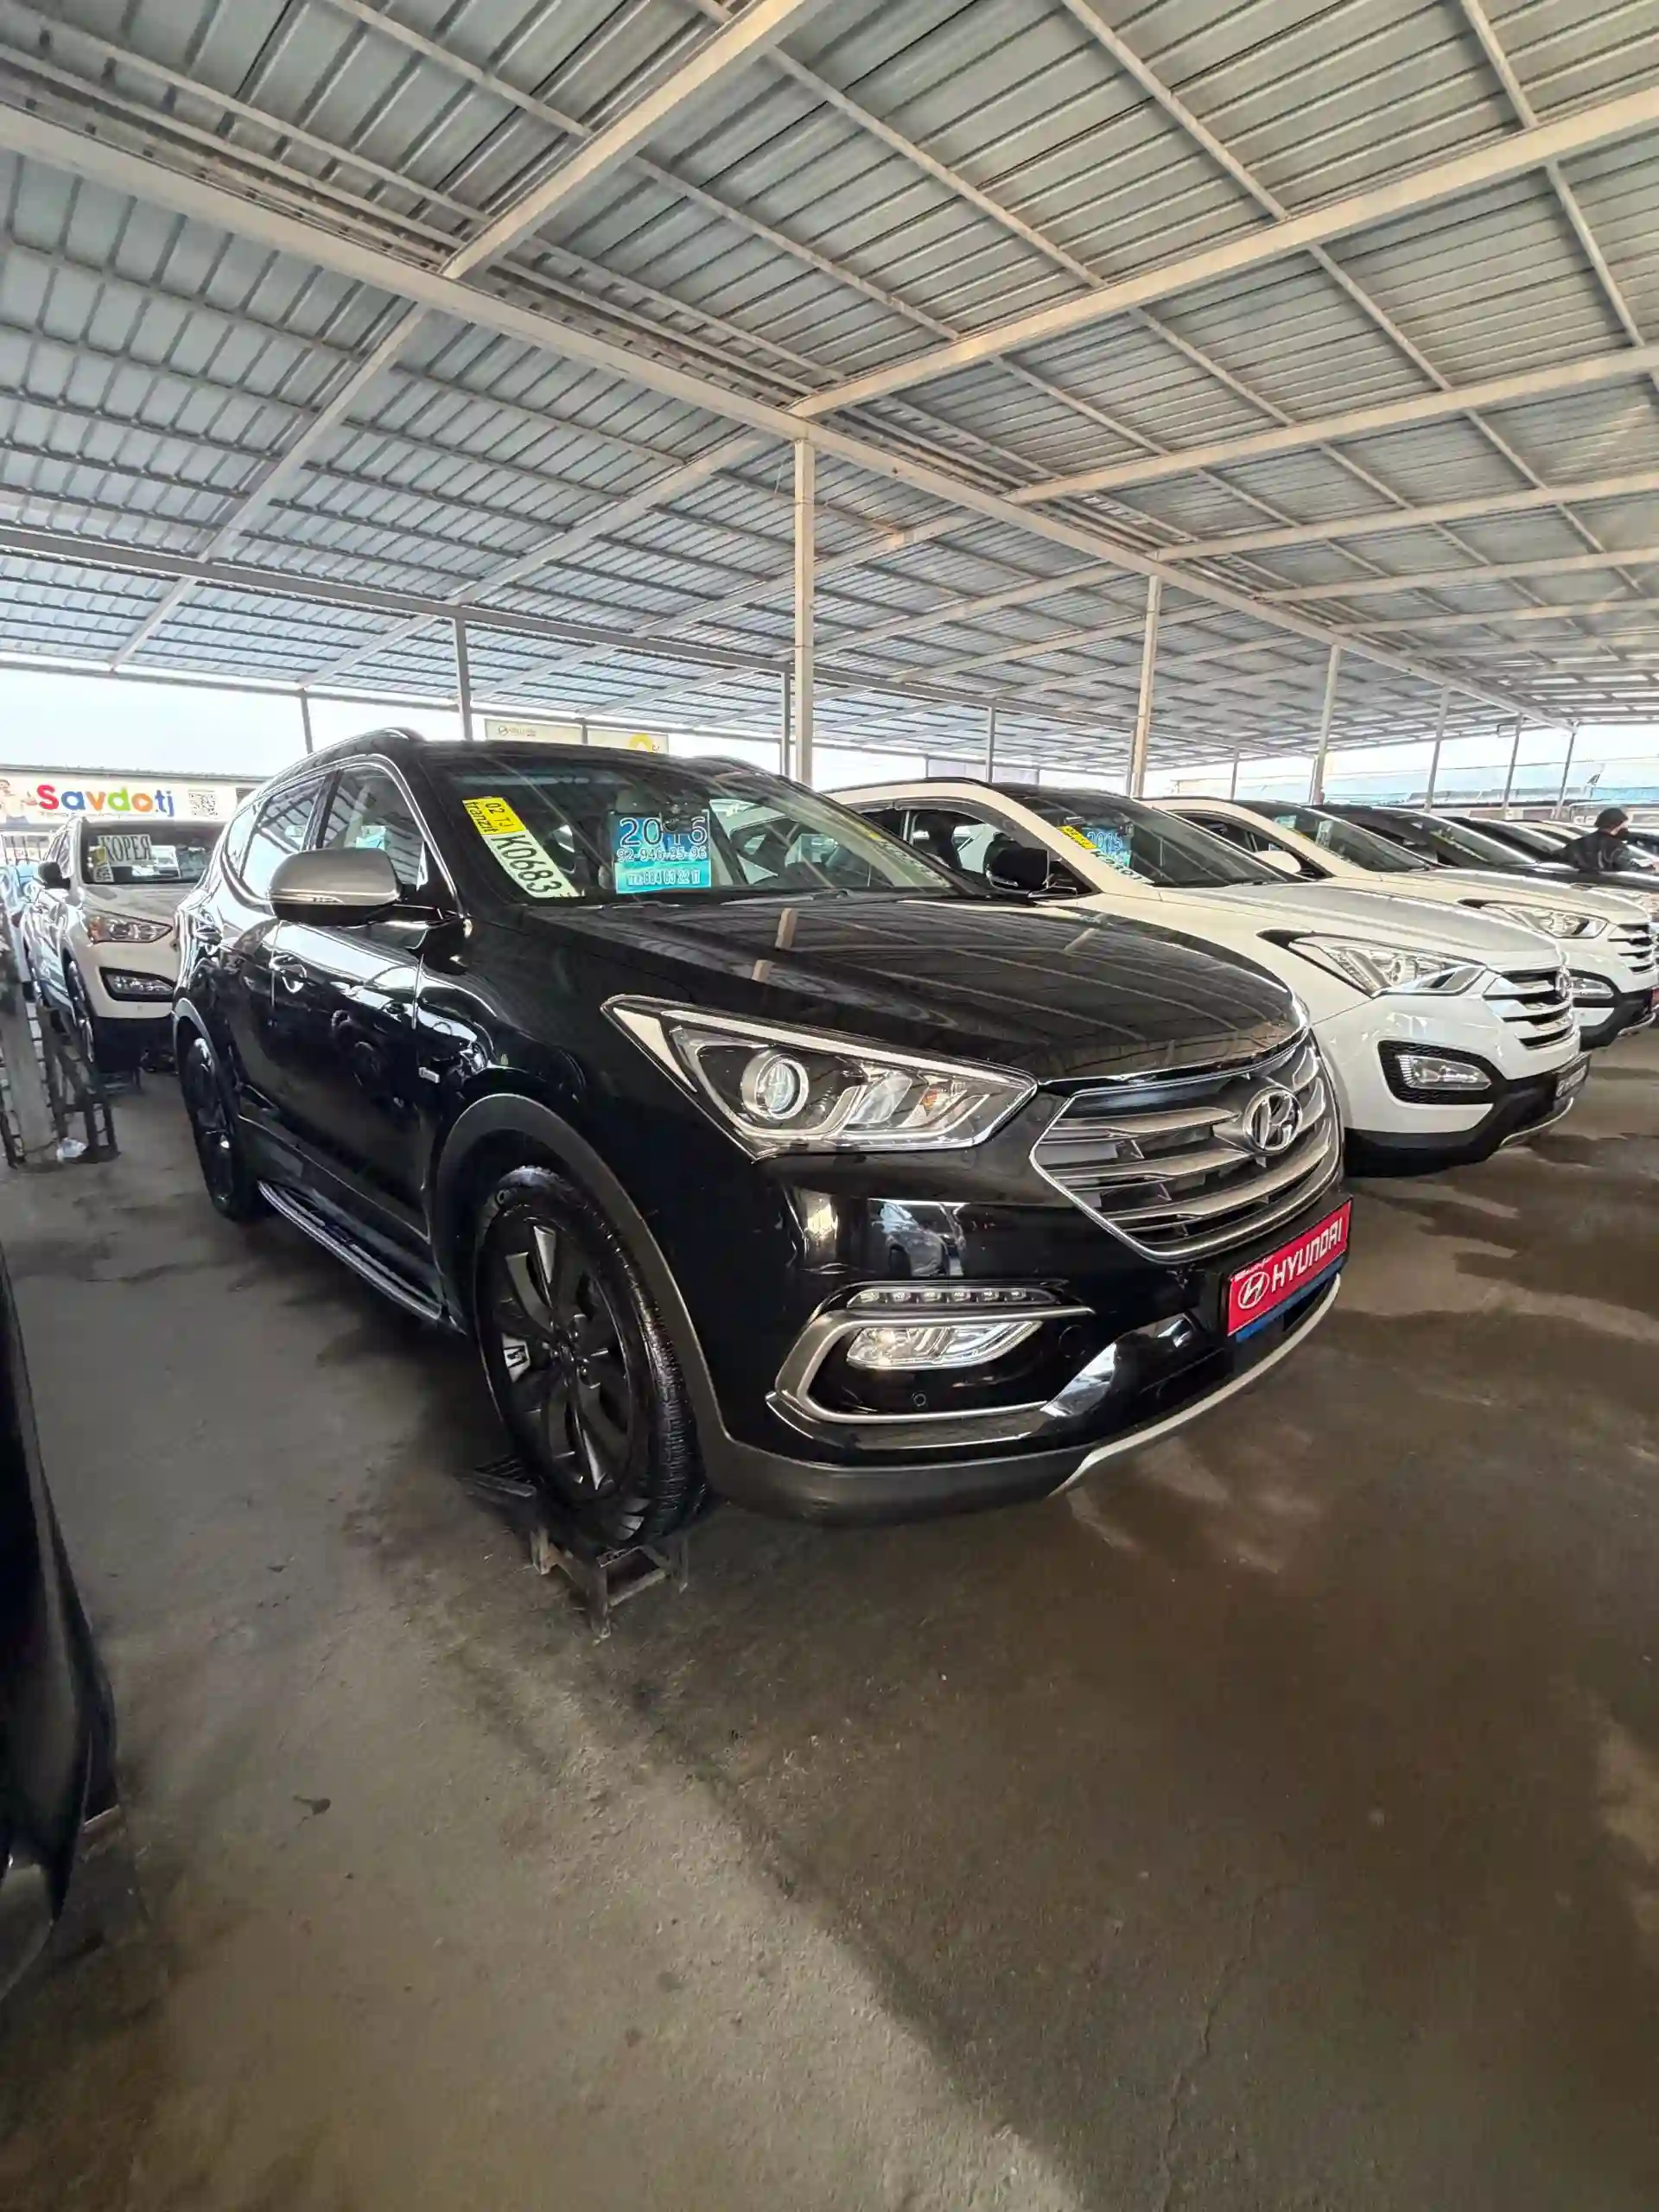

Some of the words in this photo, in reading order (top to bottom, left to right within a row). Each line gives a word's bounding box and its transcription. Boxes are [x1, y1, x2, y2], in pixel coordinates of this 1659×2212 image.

[465, 801, 499, 832] tranzit
[485, 802, 505, 814] 02
[493, 817, 515, 827] TJ
[101, 836, 153, 861] КОРЕЯ
[491, 835, 563, 893] K0683
[1271, 1217, 1344, 1293] HYUNDAI
